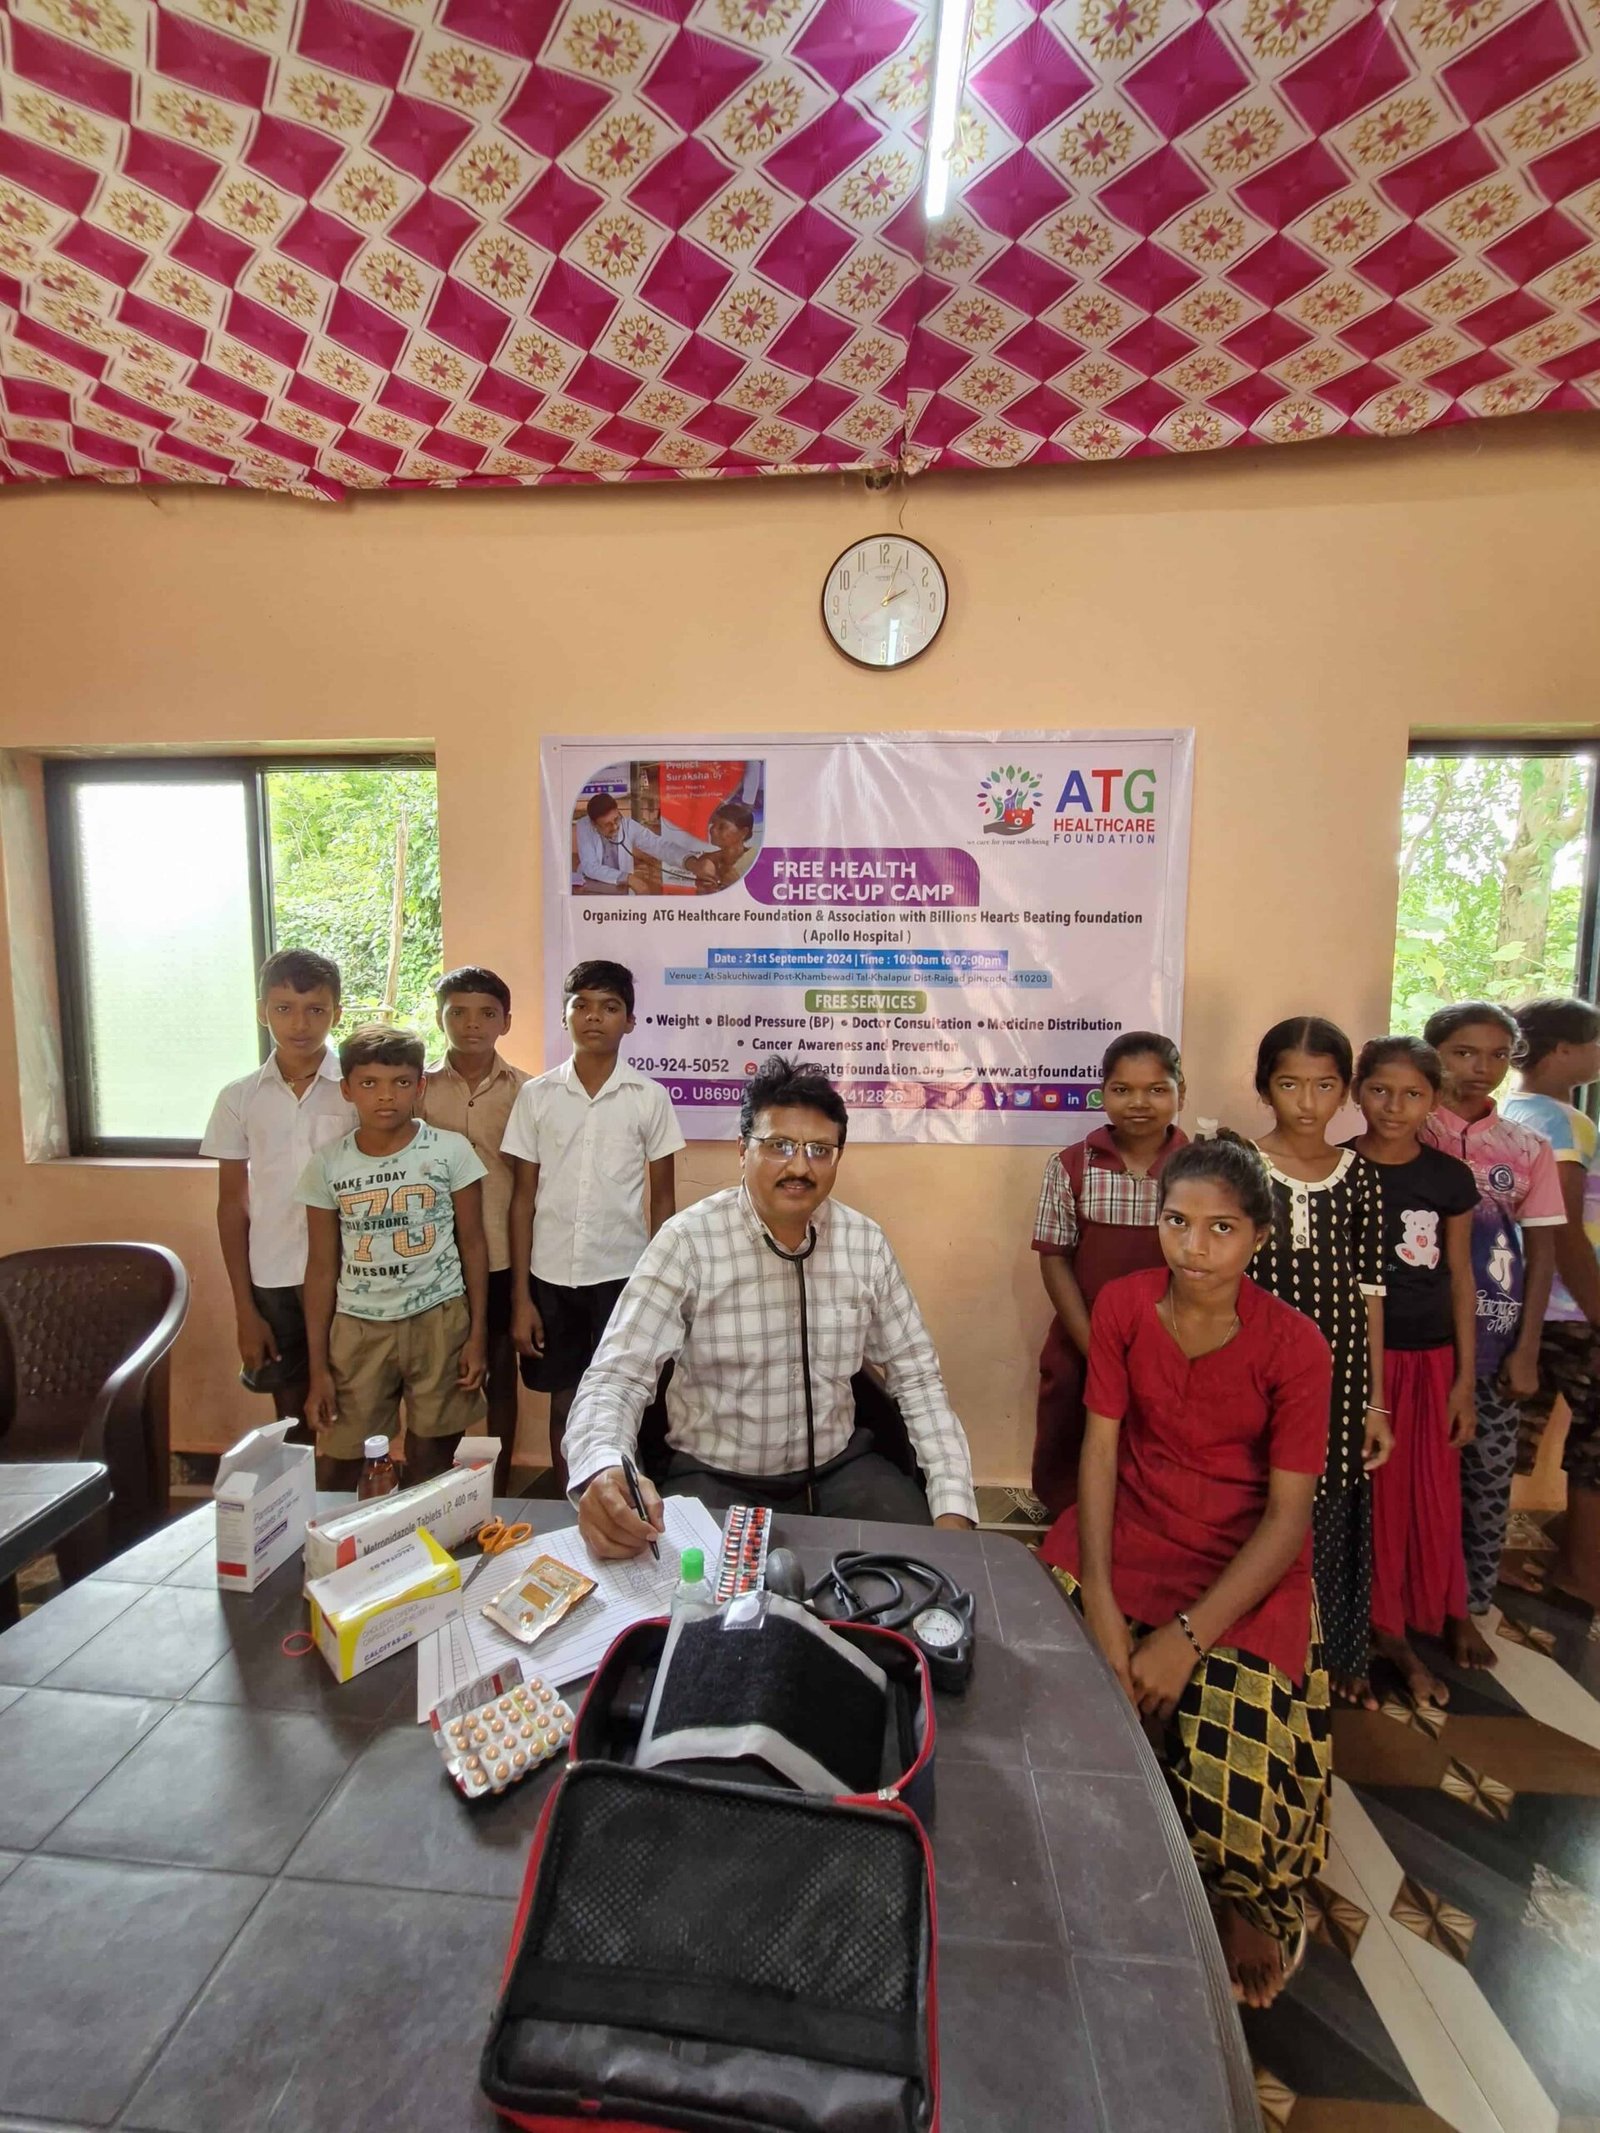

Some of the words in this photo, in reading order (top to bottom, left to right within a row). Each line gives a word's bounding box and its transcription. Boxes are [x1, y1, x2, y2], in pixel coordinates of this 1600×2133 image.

[857, 551, 865, 572] 11
[879, 543, 890, 564] 12
[839, 569, 850, 591] 10
[921, 566, 929, 588] 2
[833, 595, 840, 616] 9
[929, 592, 936, 613] 3
[840, 619, 847, 640] 8
[1055, 768, 1157, 814] ATG
[1054, 818, 1156, 832] HEALTHCARE
[1002, 839, 1016, 847] your
[1017, 838, 1050, 847] well-being
[1054, 833, 1155, 844] FOUNDATION
[773, 861, 824, 878] FREE
[830, 862, 917, 879] HEALTH
[772, 883, 884, 901] CHECK-UP
[890, 884, 955, 902] CAMP
[583, 909, 647, 924] Organizing
[653, 910, 675, 921] ATG
[678, 910, 741, 922] Healthcare
[744, 910, 812, 922] Foundation
[815, 911, 824, 922] &
[827, 911, 896, 923] Association
[899, 911, 926, 923] with
[929, 911, 977, 923] Billions
[980, 911, 1020, 923] Hearts
[1023, 912, 1071, 926] Beating
[1074, 912, 1142, 924] foundation
[810, 931, 850, 944] Apollo
[853, 931, 904, 945] Hospital
[714, 954, 737, 964] Date
[745, 954, 767, 964] 21st
[769, 954, 825, 967] September
[826, 954, 852, 965] 2024
[860, 955, 884, 965] Time
[894, 955, 938, 966] 10:00am
[941, 956, 952, 966] to
[953, 956, 1001, 969] 02:00pm
[669, 971, 697, 980] Venue
[704, 971, 772, 980] At-Sakuchiwadi
[773, 972, 854, 981] Post-Khambewadi
[856, 973, 911, 984] Tal-Khalapur
[914, 973, 965, 984] Dist-Raigad
[815, 994, 850, 1008] FREE
[851, 995, 916, 1009] SERVICES
[656, 1014, 700, 1029] Weight
[717, 1014, 751, 1027] Blood
[754, 1015, 806, 1028] Pressure
[809, 1016, 835, 1030] (BP)
[852, 1017, 891, 1029] Doctor
[893, 1018, 972, 1030] Consultation
[987, 1018, 1044, 1031] Medicine
[1047, 1018, 1122, 1031] Distribution
[752, 1038, 793, 1050] Cancer
[798, 1039, 863, 1051] Awareness
[865, 1040, 889, 1052] and
[891, 1040, 960, 1052] Prevention
[667, 1086, 688, 1100] O.
[333, 1177, 362, 1192] MAKE
[369, 1170, 407, 1184] TODAY
[363, 1216, 409, 1231] STRONG
[346, 1263, 409, 1277] AWESOME
[416, 1509, 442, 1527] Tablets
[454, 1493, 467, 1507] 400
